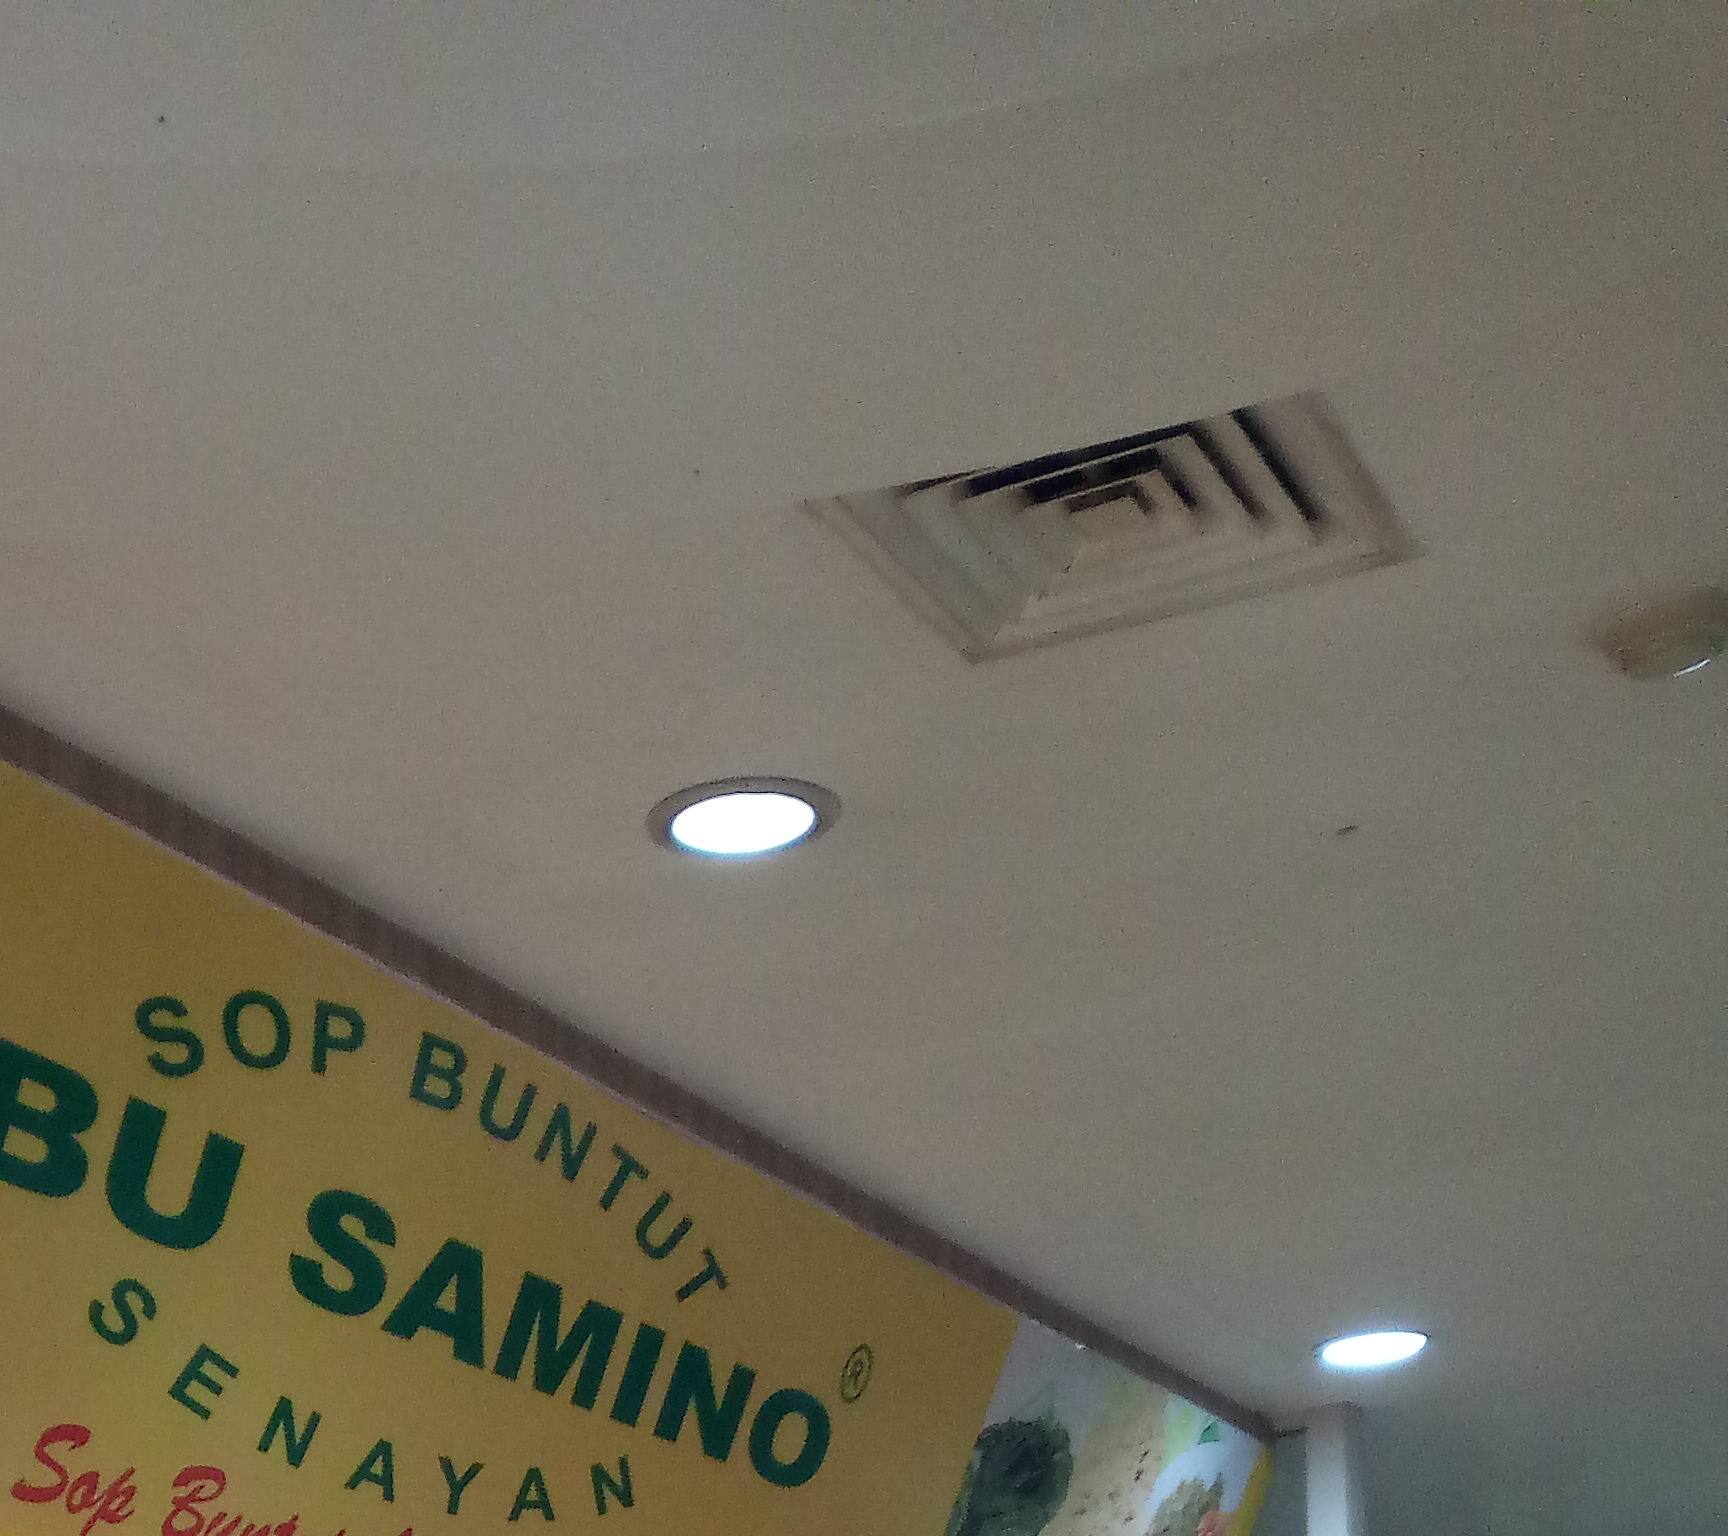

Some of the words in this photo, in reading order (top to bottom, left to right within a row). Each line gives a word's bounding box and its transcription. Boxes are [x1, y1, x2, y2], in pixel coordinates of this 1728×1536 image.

[133, 990, 365, 1081] SOP
[409, 1033, 728, 1302] BUNTUT
[88, 1278, 634, 1523] SENAYAN
[289, 1189, 830, 1489] SAMINO
